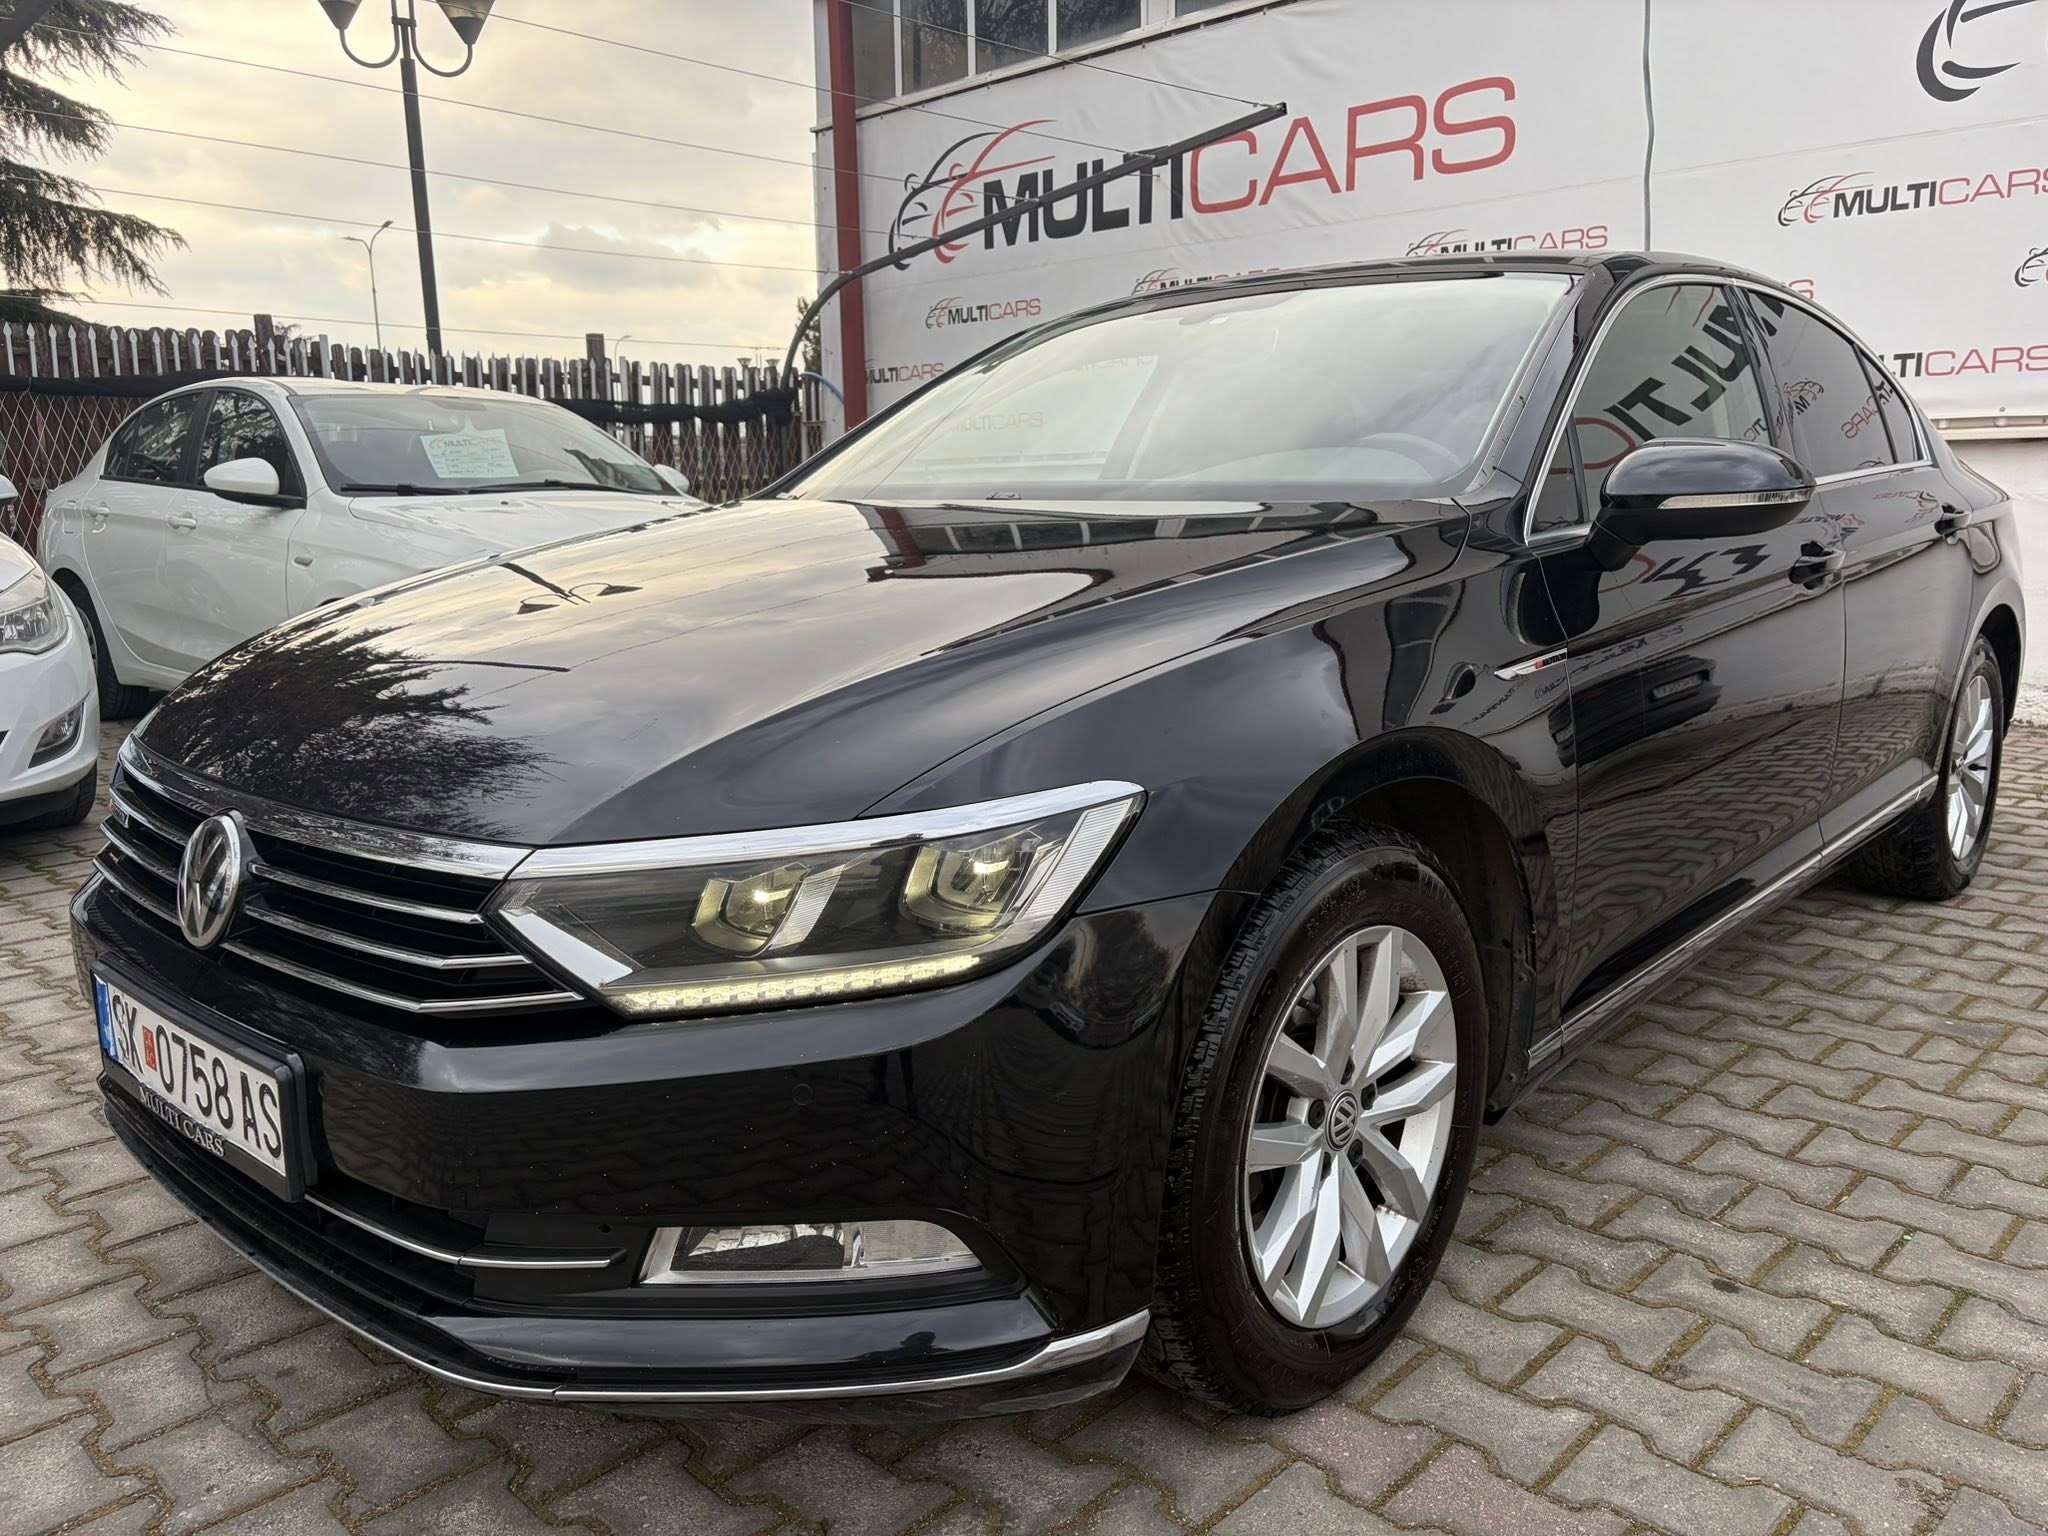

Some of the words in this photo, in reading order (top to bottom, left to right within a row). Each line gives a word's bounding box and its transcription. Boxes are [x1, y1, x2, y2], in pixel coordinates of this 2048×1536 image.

[948, 298, 1041, 325] MULTICARS
[1878, 345, 2048, 379] TICARS
[112, 994, 144, 1074] SK
[156, 1024, 234, 1130] 0758
[240, 1071, 282, 1159] AS
[139, 1085, 181, 1131] MULTI
[183, 1119, 225, 1158] CARS
